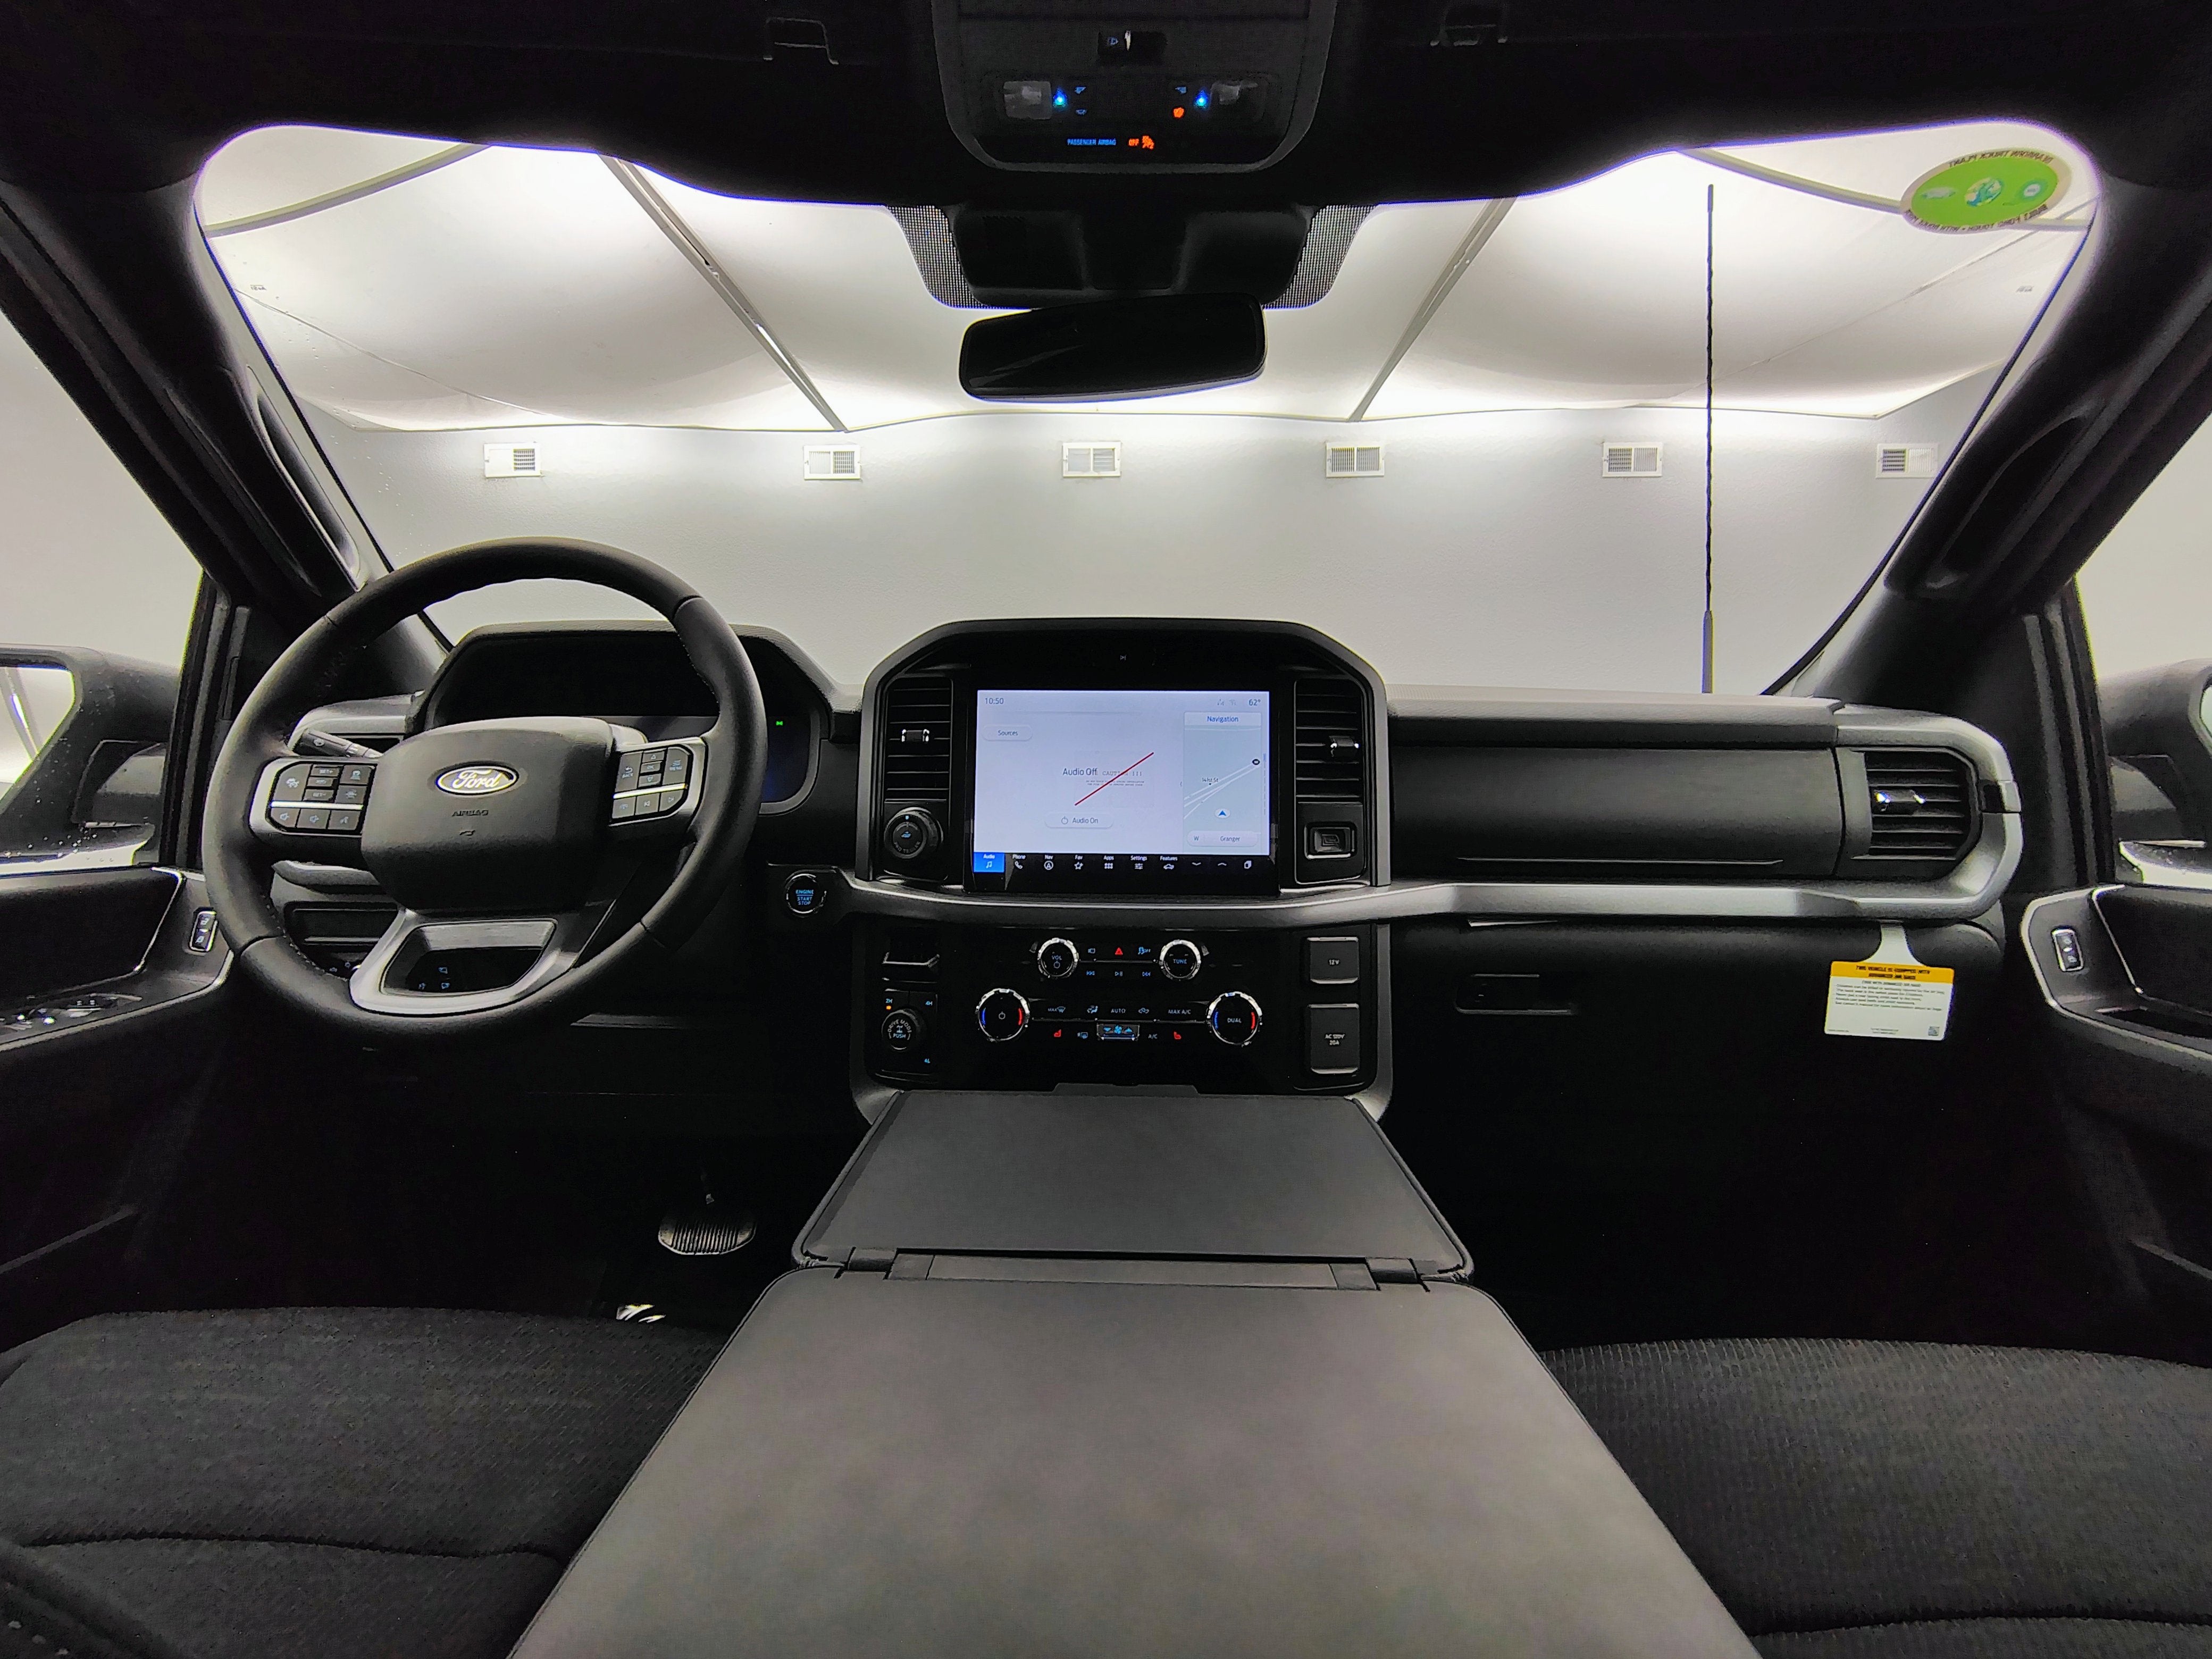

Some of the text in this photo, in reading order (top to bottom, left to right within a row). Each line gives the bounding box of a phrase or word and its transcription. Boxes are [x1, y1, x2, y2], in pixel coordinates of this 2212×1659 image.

[1062, 767, 1098, 776] Audio Off
[451, 769, 501, 789] Ford
